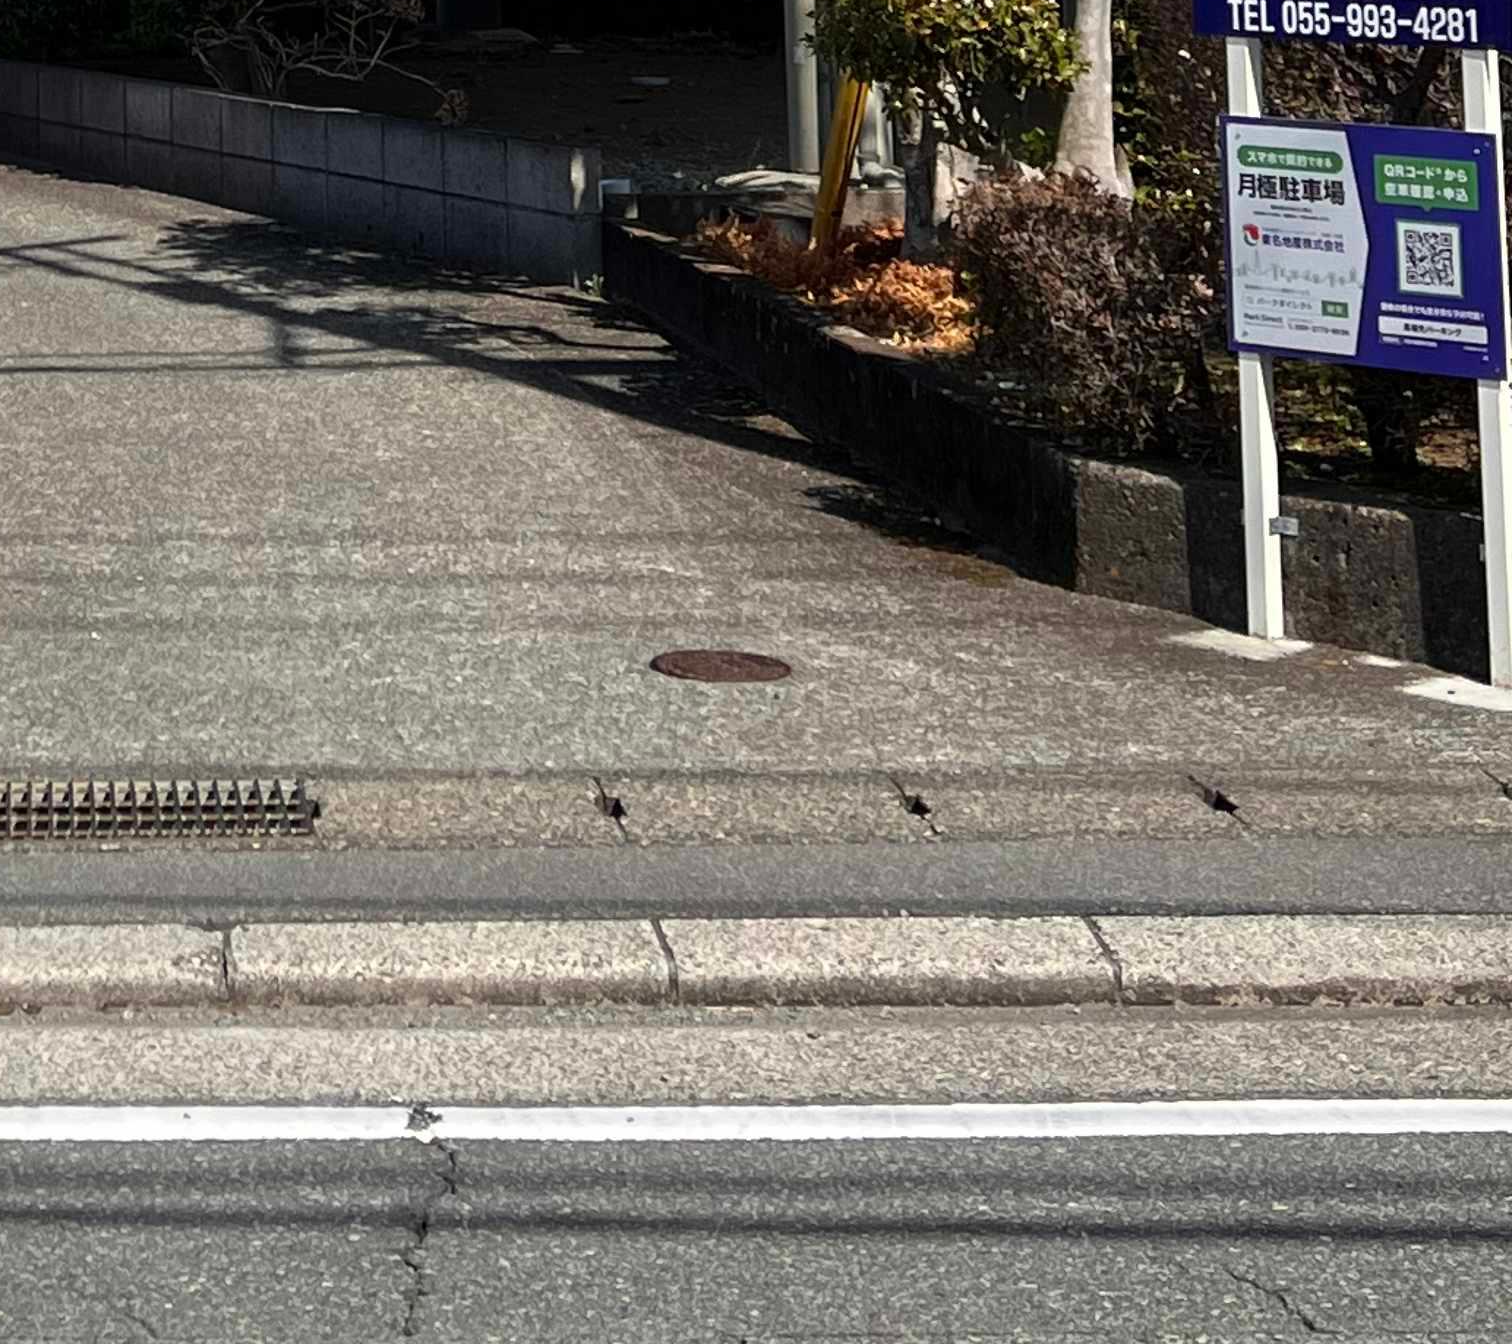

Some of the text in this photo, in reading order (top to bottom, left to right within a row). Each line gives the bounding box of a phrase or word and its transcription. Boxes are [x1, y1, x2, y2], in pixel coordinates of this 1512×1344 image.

[1282, 1, 1479, 43] 055-993-4281
[1237, 173, 1345, 206] 月極駐車場
[1262, 234, 1345, 253] 東名地産株式会社
